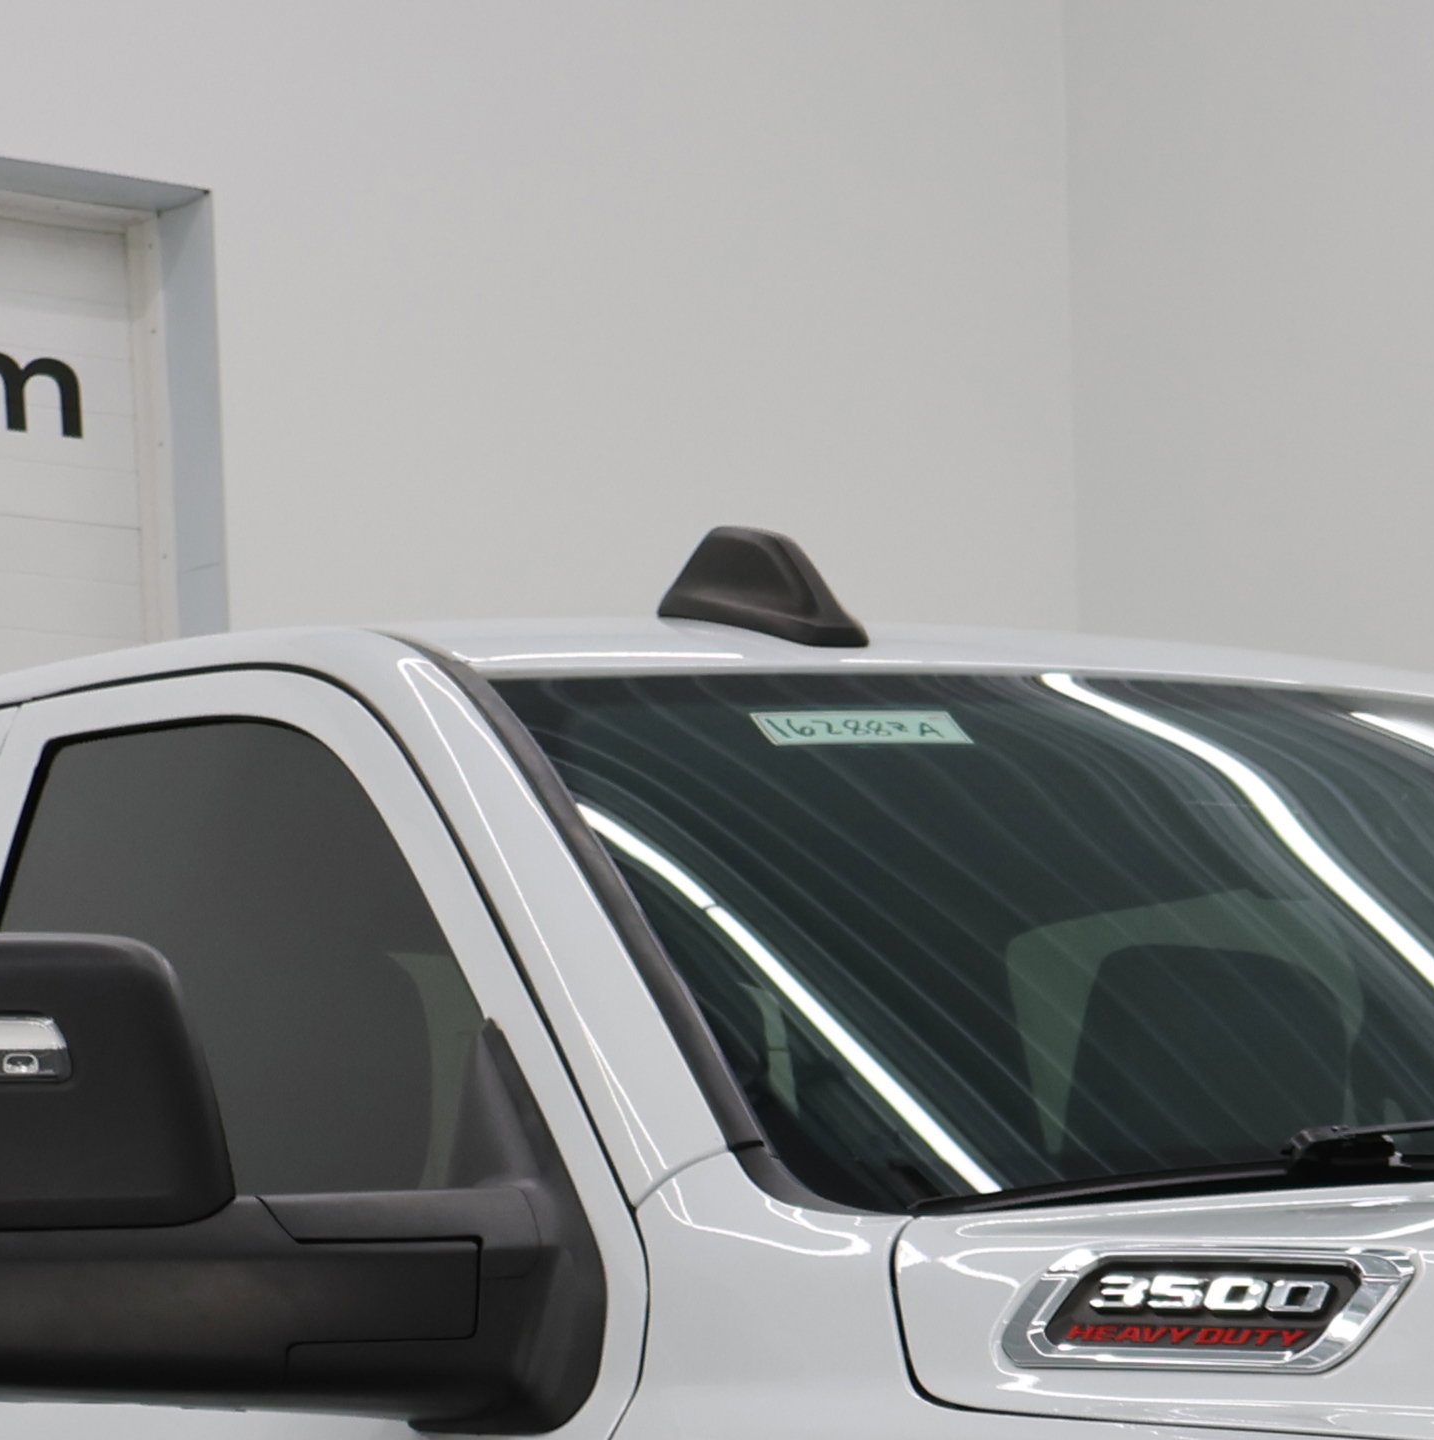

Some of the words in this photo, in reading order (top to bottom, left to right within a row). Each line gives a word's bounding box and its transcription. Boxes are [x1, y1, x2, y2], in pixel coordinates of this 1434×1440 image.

[1088, 1273, 1332, 1314] 3500
[1067, 1324, 1194, 1345] HEAVY
[1193, 1327, 1307, 1347] DUTY
